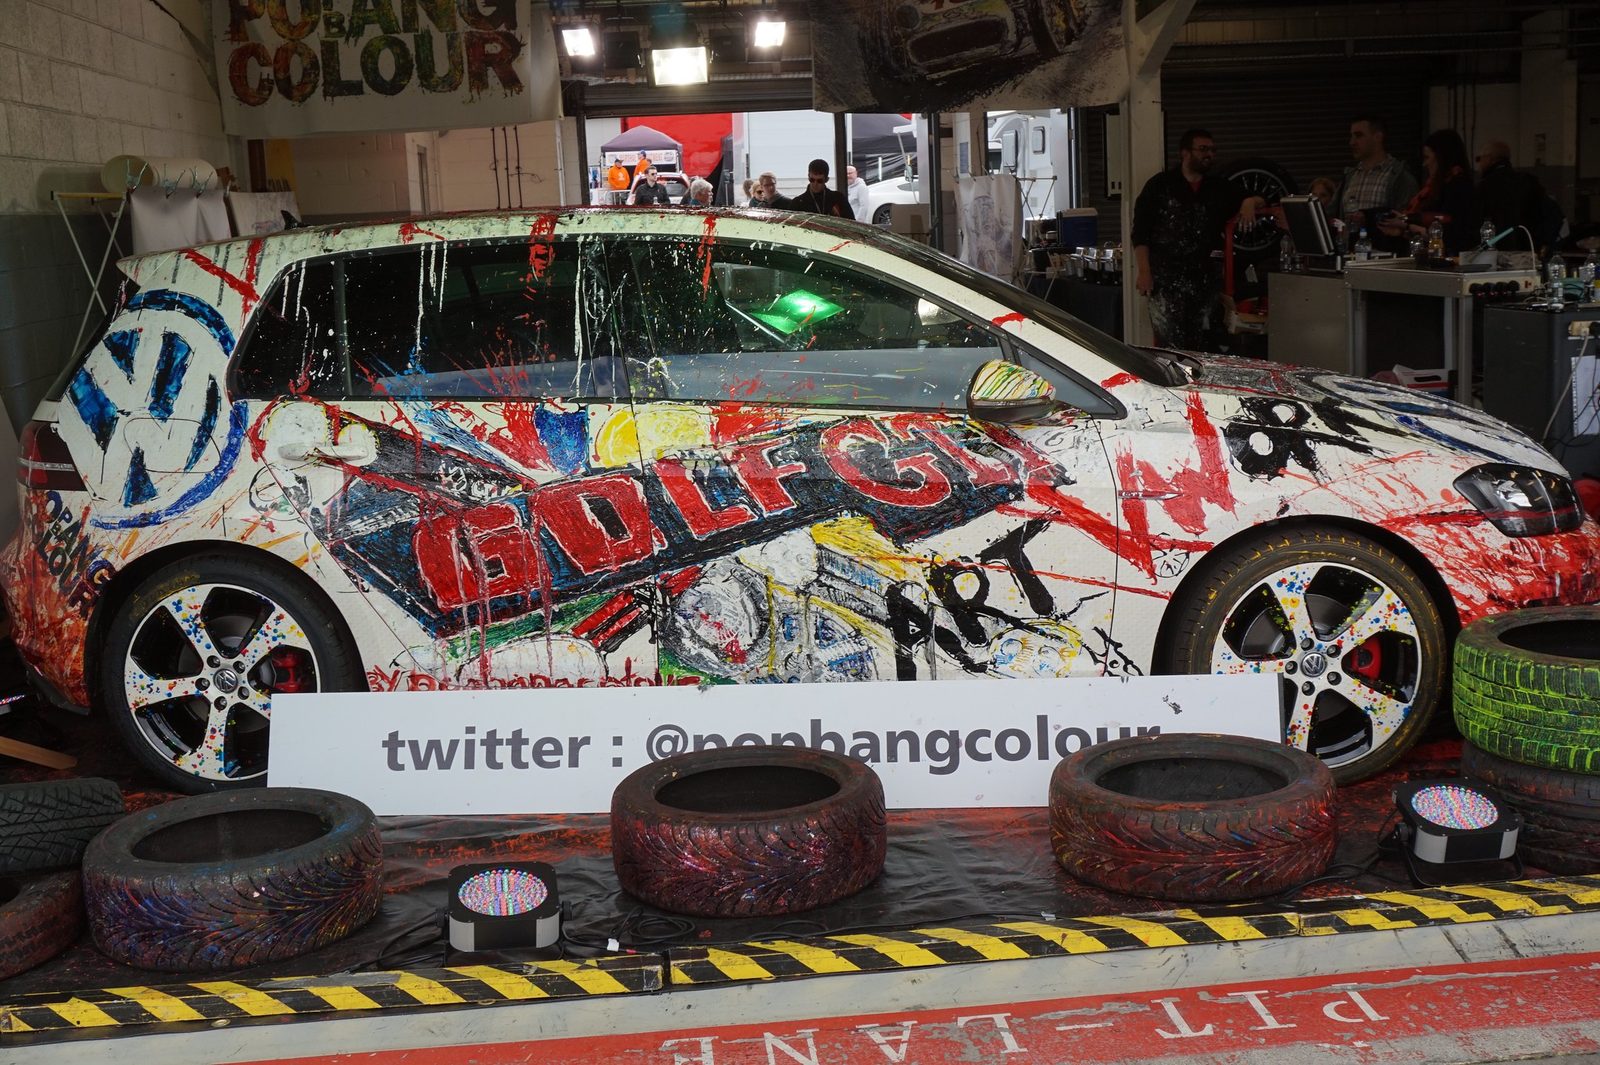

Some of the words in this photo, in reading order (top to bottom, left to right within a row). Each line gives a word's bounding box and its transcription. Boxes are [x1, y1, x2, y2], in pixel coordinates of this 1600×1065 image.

[228, 32, 525, 106] COLOUR
[382, 726, 591, 772] twitter
[646, 715, 1161, 776] @bangcolo
[659, 1012, 1028, 1065] LANE
[1151, 982, 1389, 1039] PIT
